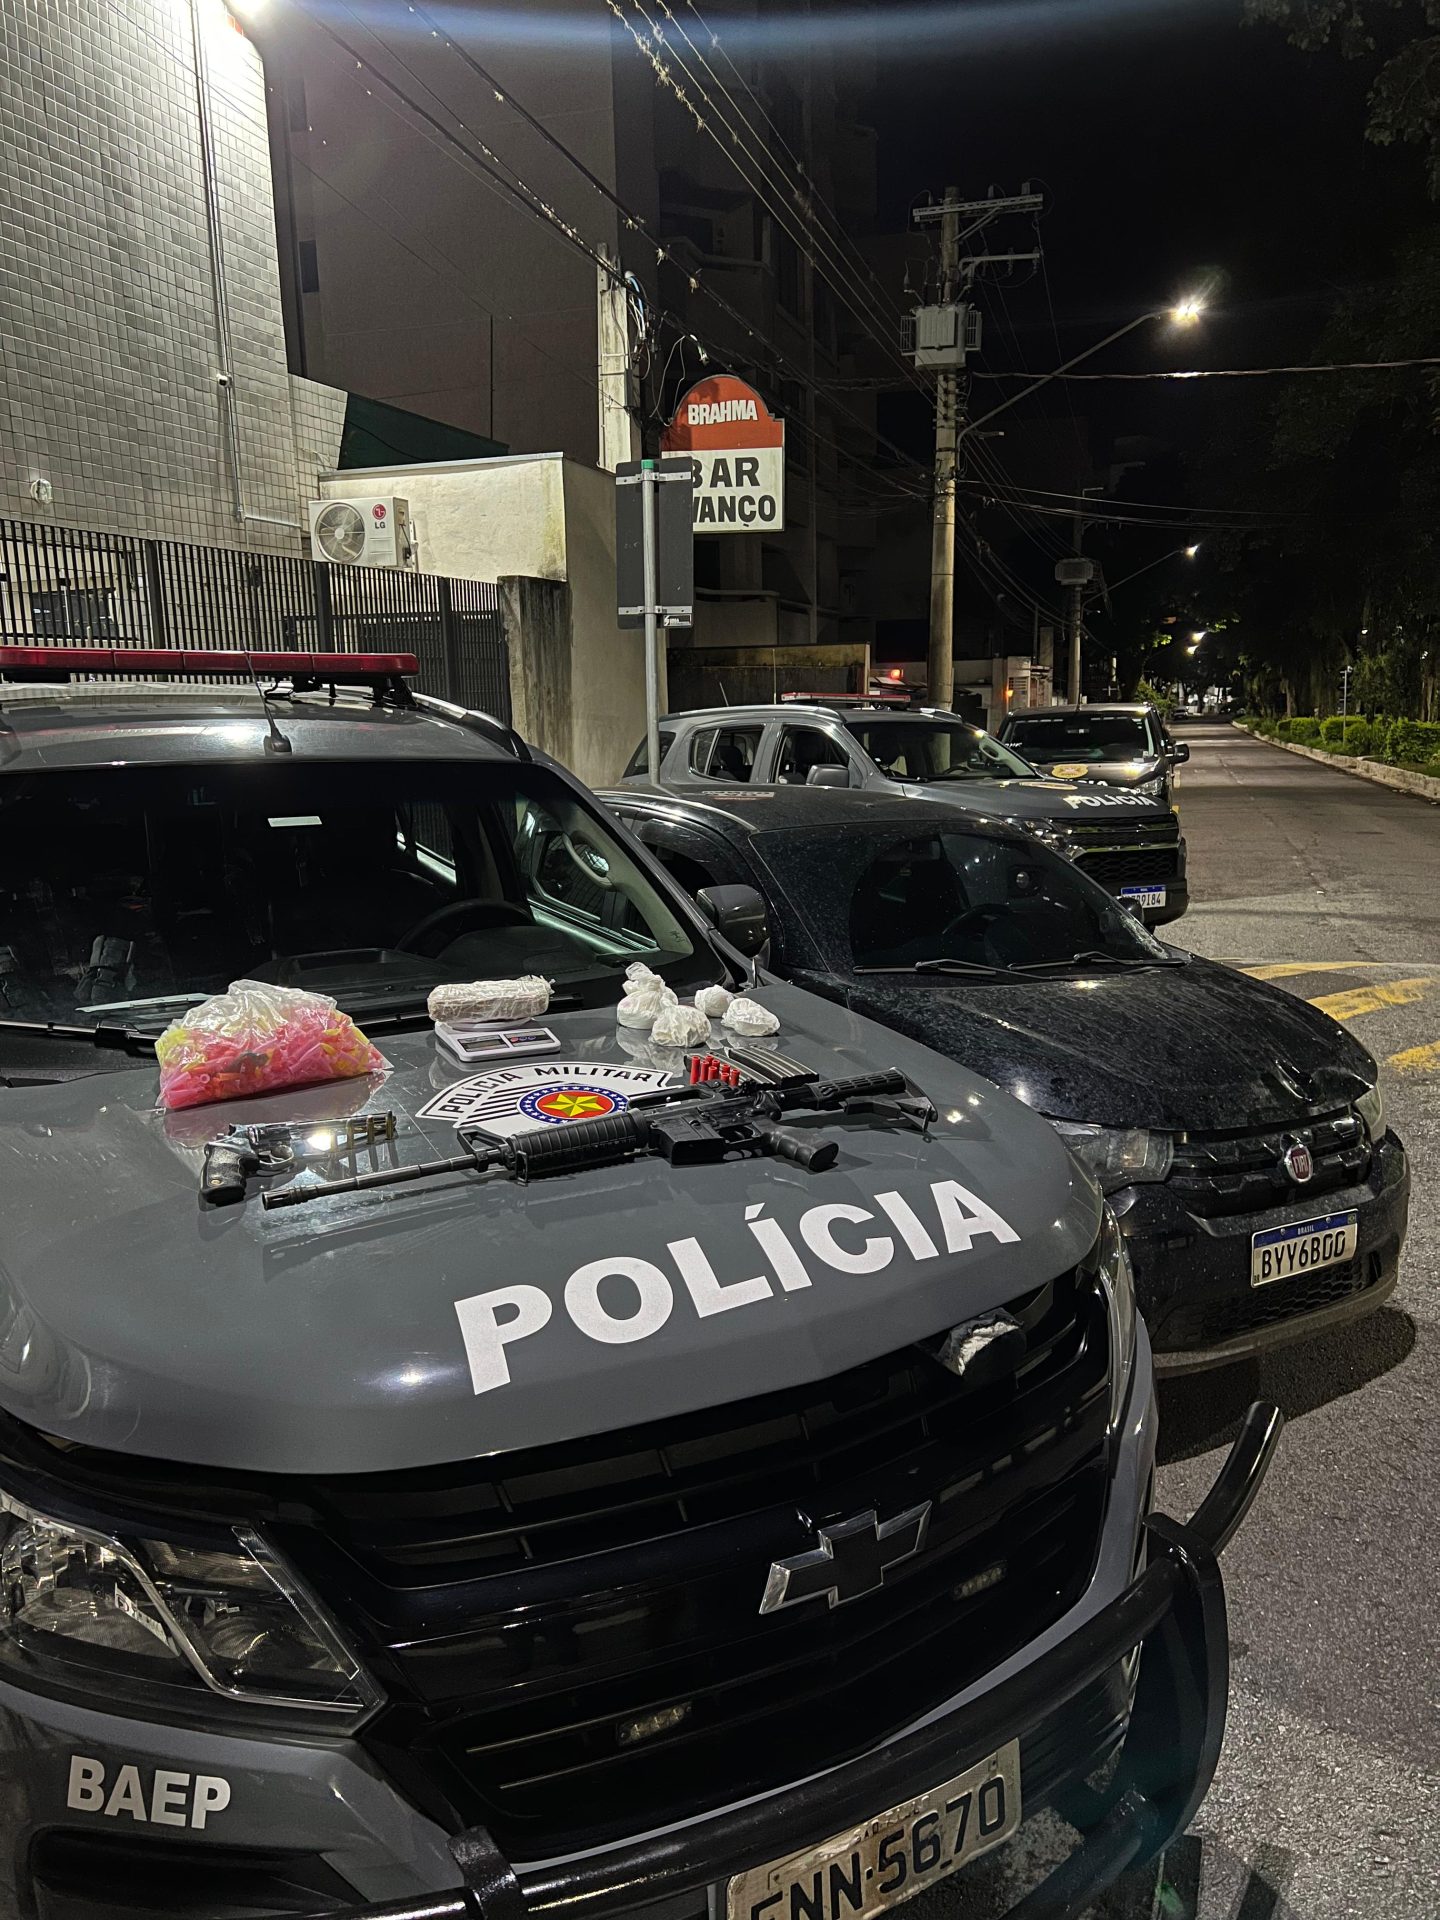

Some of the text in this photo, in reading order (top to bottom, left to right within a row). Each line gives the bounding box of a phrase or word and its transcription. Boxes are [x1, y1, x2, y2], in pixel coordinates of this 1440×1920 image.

[688, 400, 759, 425] BRAHMA
[375, 521, 386, 529] LG
[442, 1066, 652, 1113] POLÍCIA MILITAR
[1298, 1225, 1314, 1235] BRASIL
[454, 1180, 1021, 1395] POLÍCIA
[67, 1755, 231, 1830] BAEP
